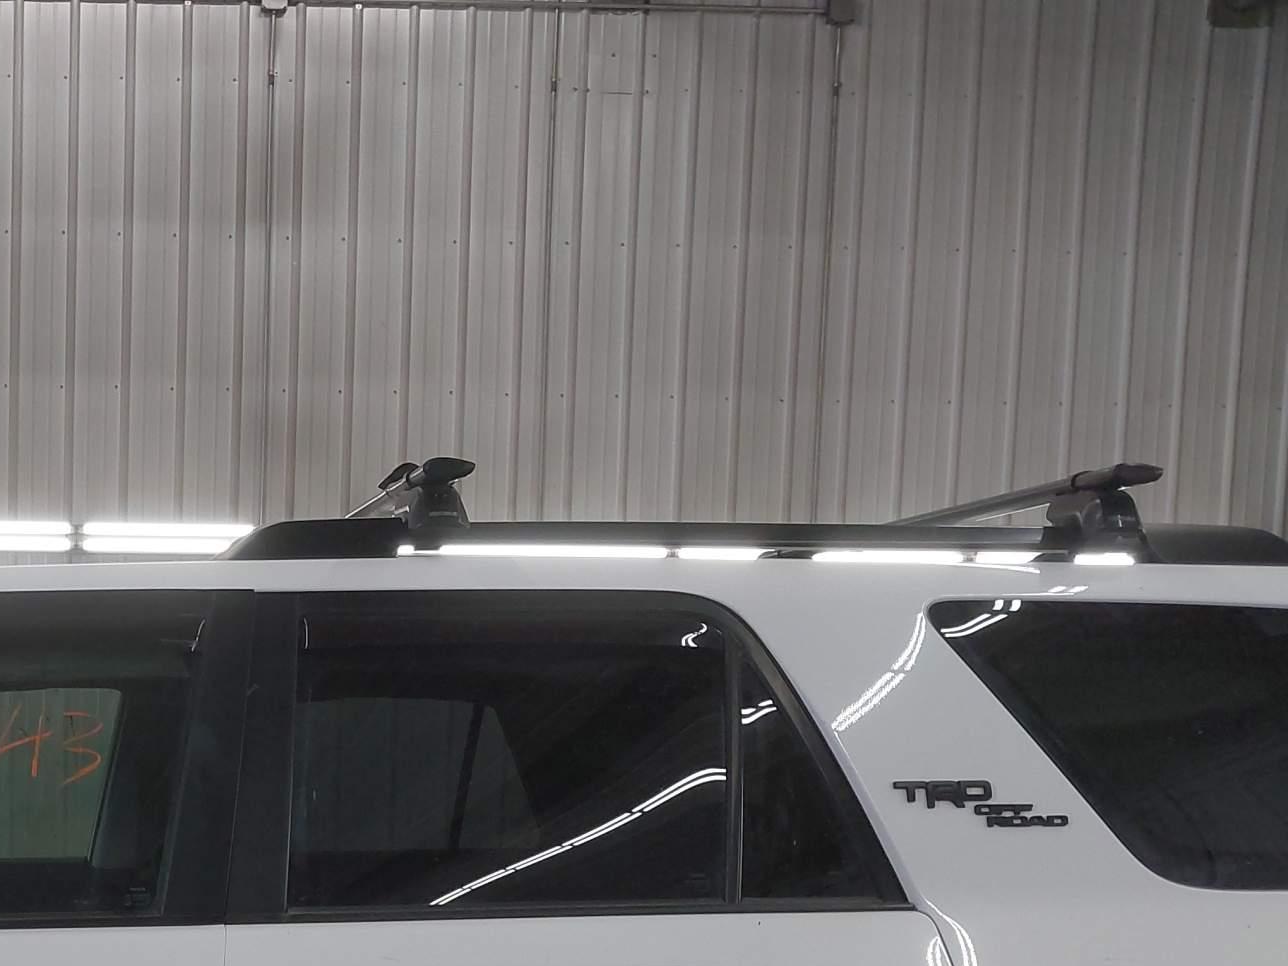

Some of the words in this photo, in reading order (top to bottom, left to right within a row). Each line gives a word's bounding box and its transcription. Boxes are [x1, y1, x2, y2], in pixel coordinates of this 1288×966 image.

[893, 780, 992, 809] TRD
[974, 804, 1033, 815] OFF
[987, 815, 1069, 828] ROAD
